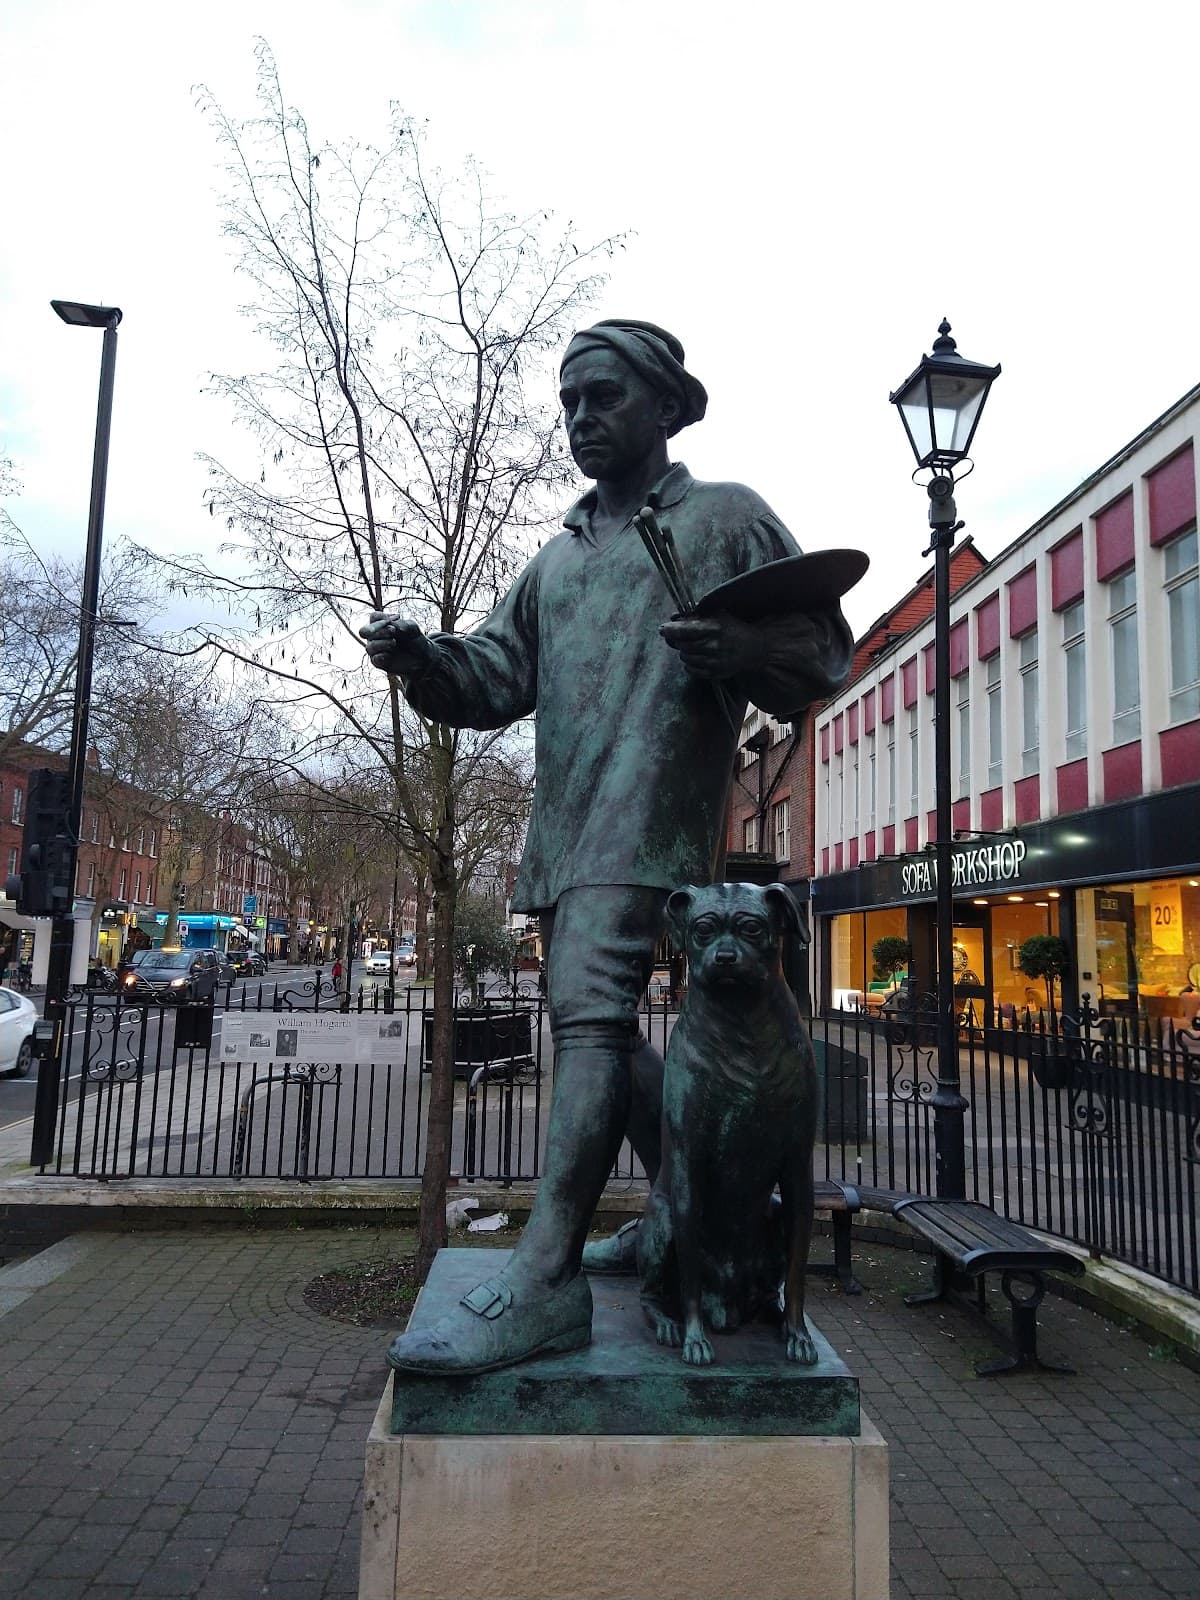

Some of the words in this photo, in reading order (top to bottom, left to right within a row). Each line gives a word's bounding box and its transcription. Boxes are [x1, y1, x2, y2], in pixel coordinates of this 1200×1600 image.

[902, 861, 932, 895] SOFA
[278, 1018, 312, 1027] William
[315, 1018, 352, 1030] Hogarth
